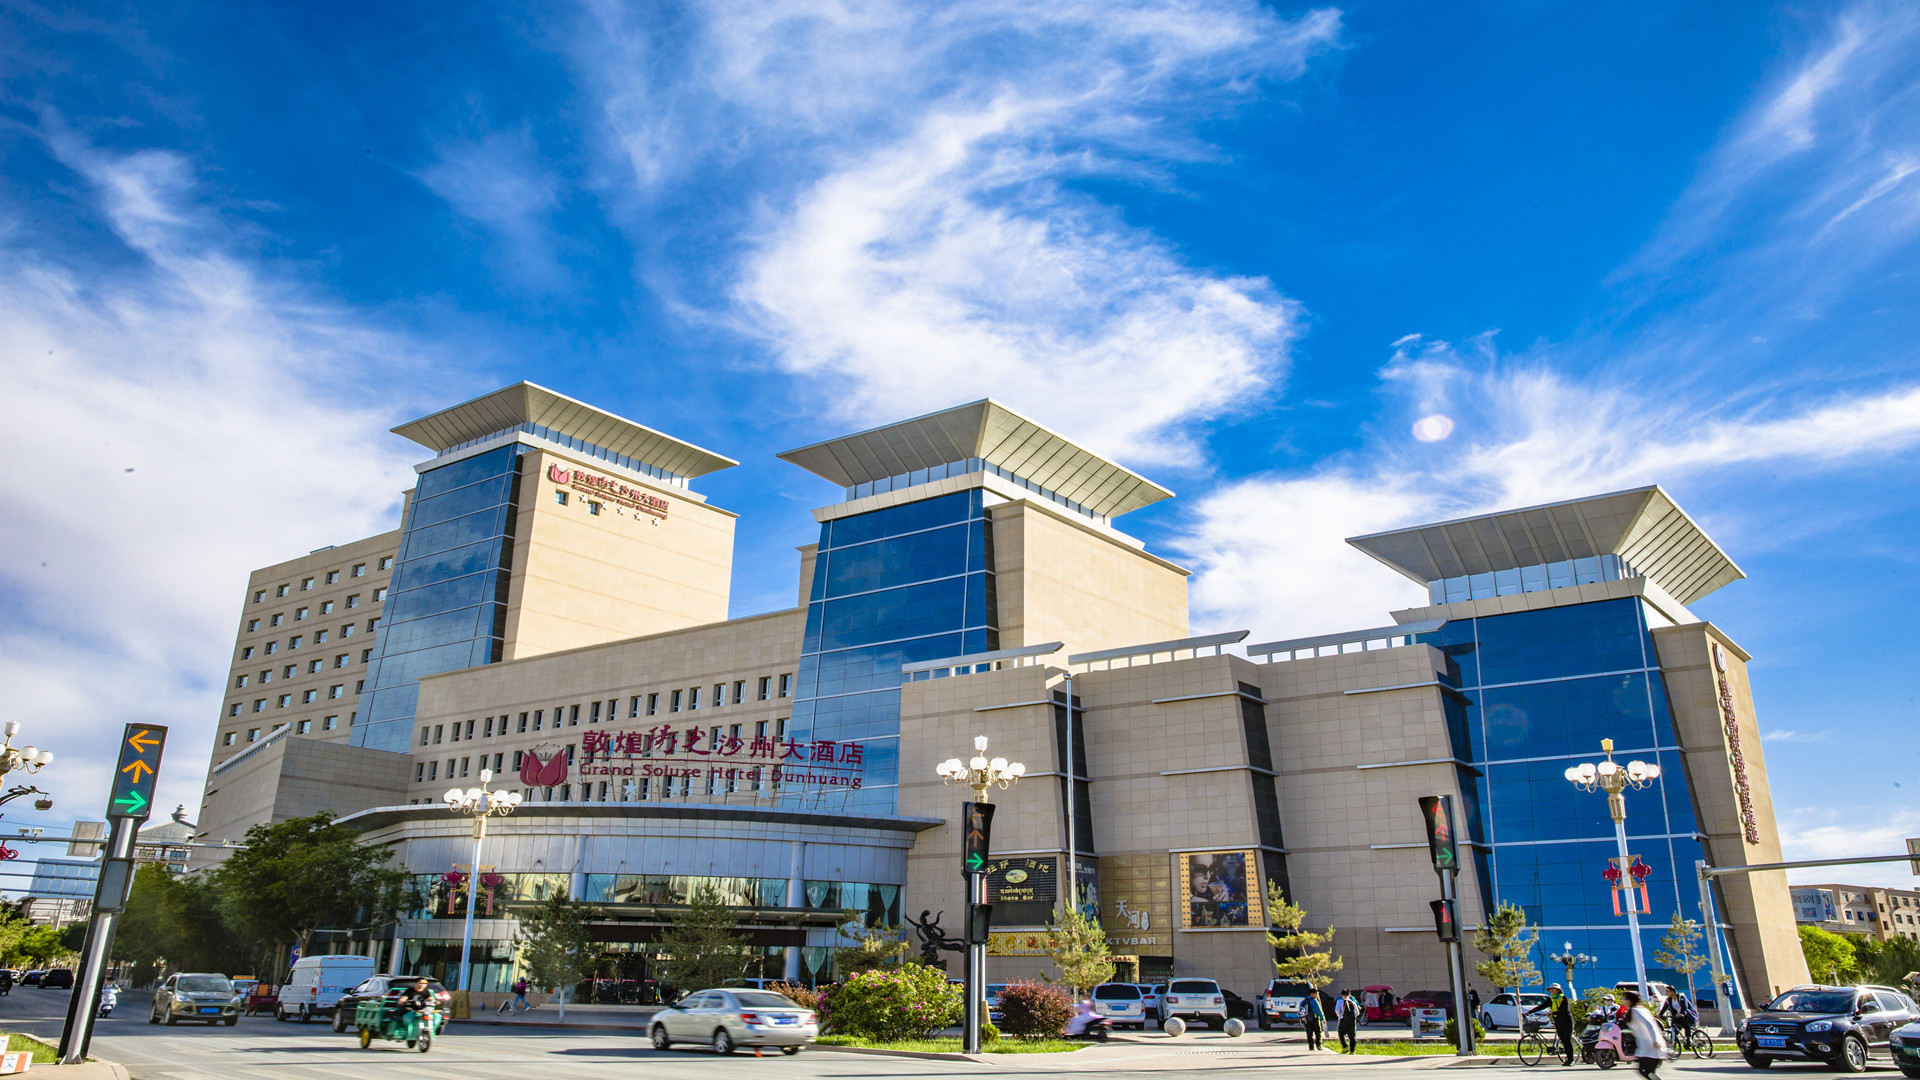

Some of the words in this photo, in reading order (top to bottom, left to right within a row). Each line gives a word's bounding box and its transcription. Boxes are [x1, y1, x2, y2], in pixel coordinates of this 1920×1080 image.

[580, 763, 633, 776] Grand
[642, 764, 700, 777] Soluxe
[711, 767, 760, 781] Hotel
[772, 769, 862, 789] Dunhuang
[1115, 899, 1140, 929] 天河
